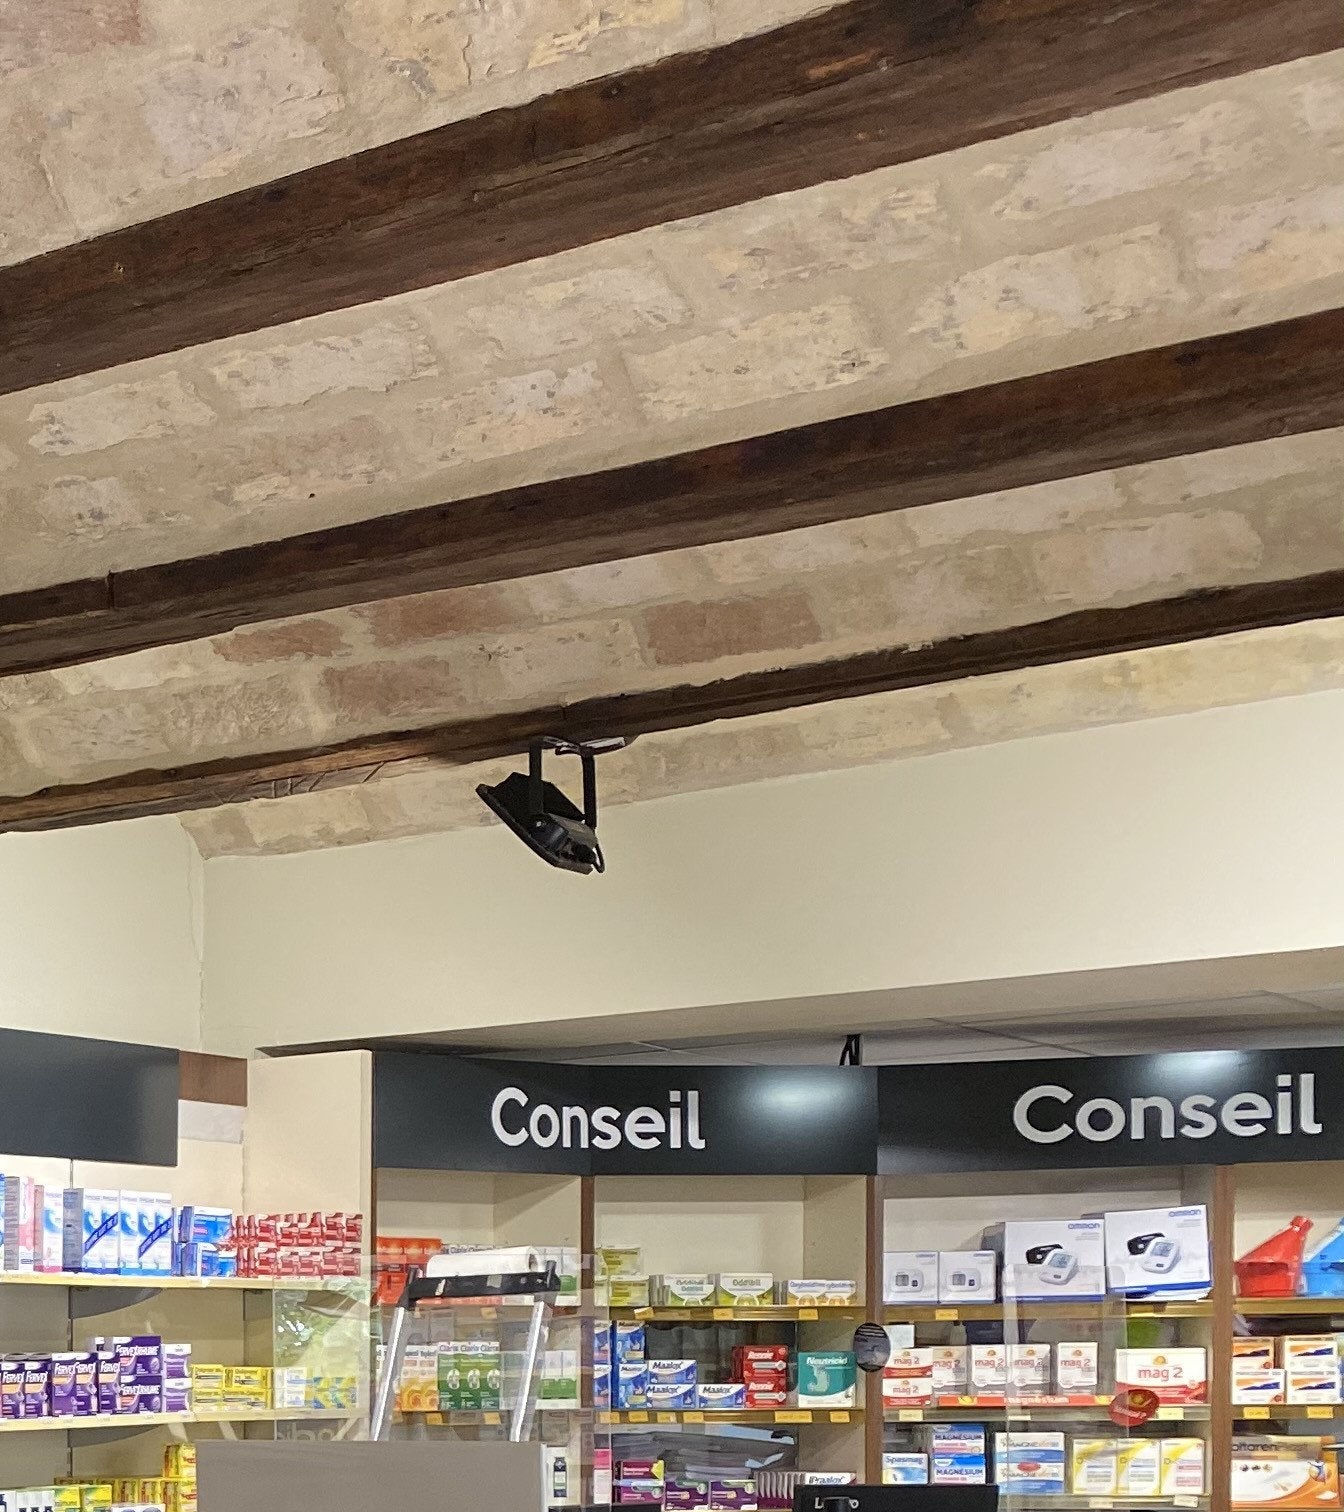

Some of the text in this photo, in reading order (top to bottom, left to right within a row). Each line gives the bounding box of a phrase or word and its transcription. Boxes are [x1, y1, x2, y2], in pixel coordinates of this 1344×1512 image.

[491, 1086, 706, 1150] Conseil
[1013, 1073, 1323, 1144] Conseil
[1138, 1366, 1183, 1381] mag 2
